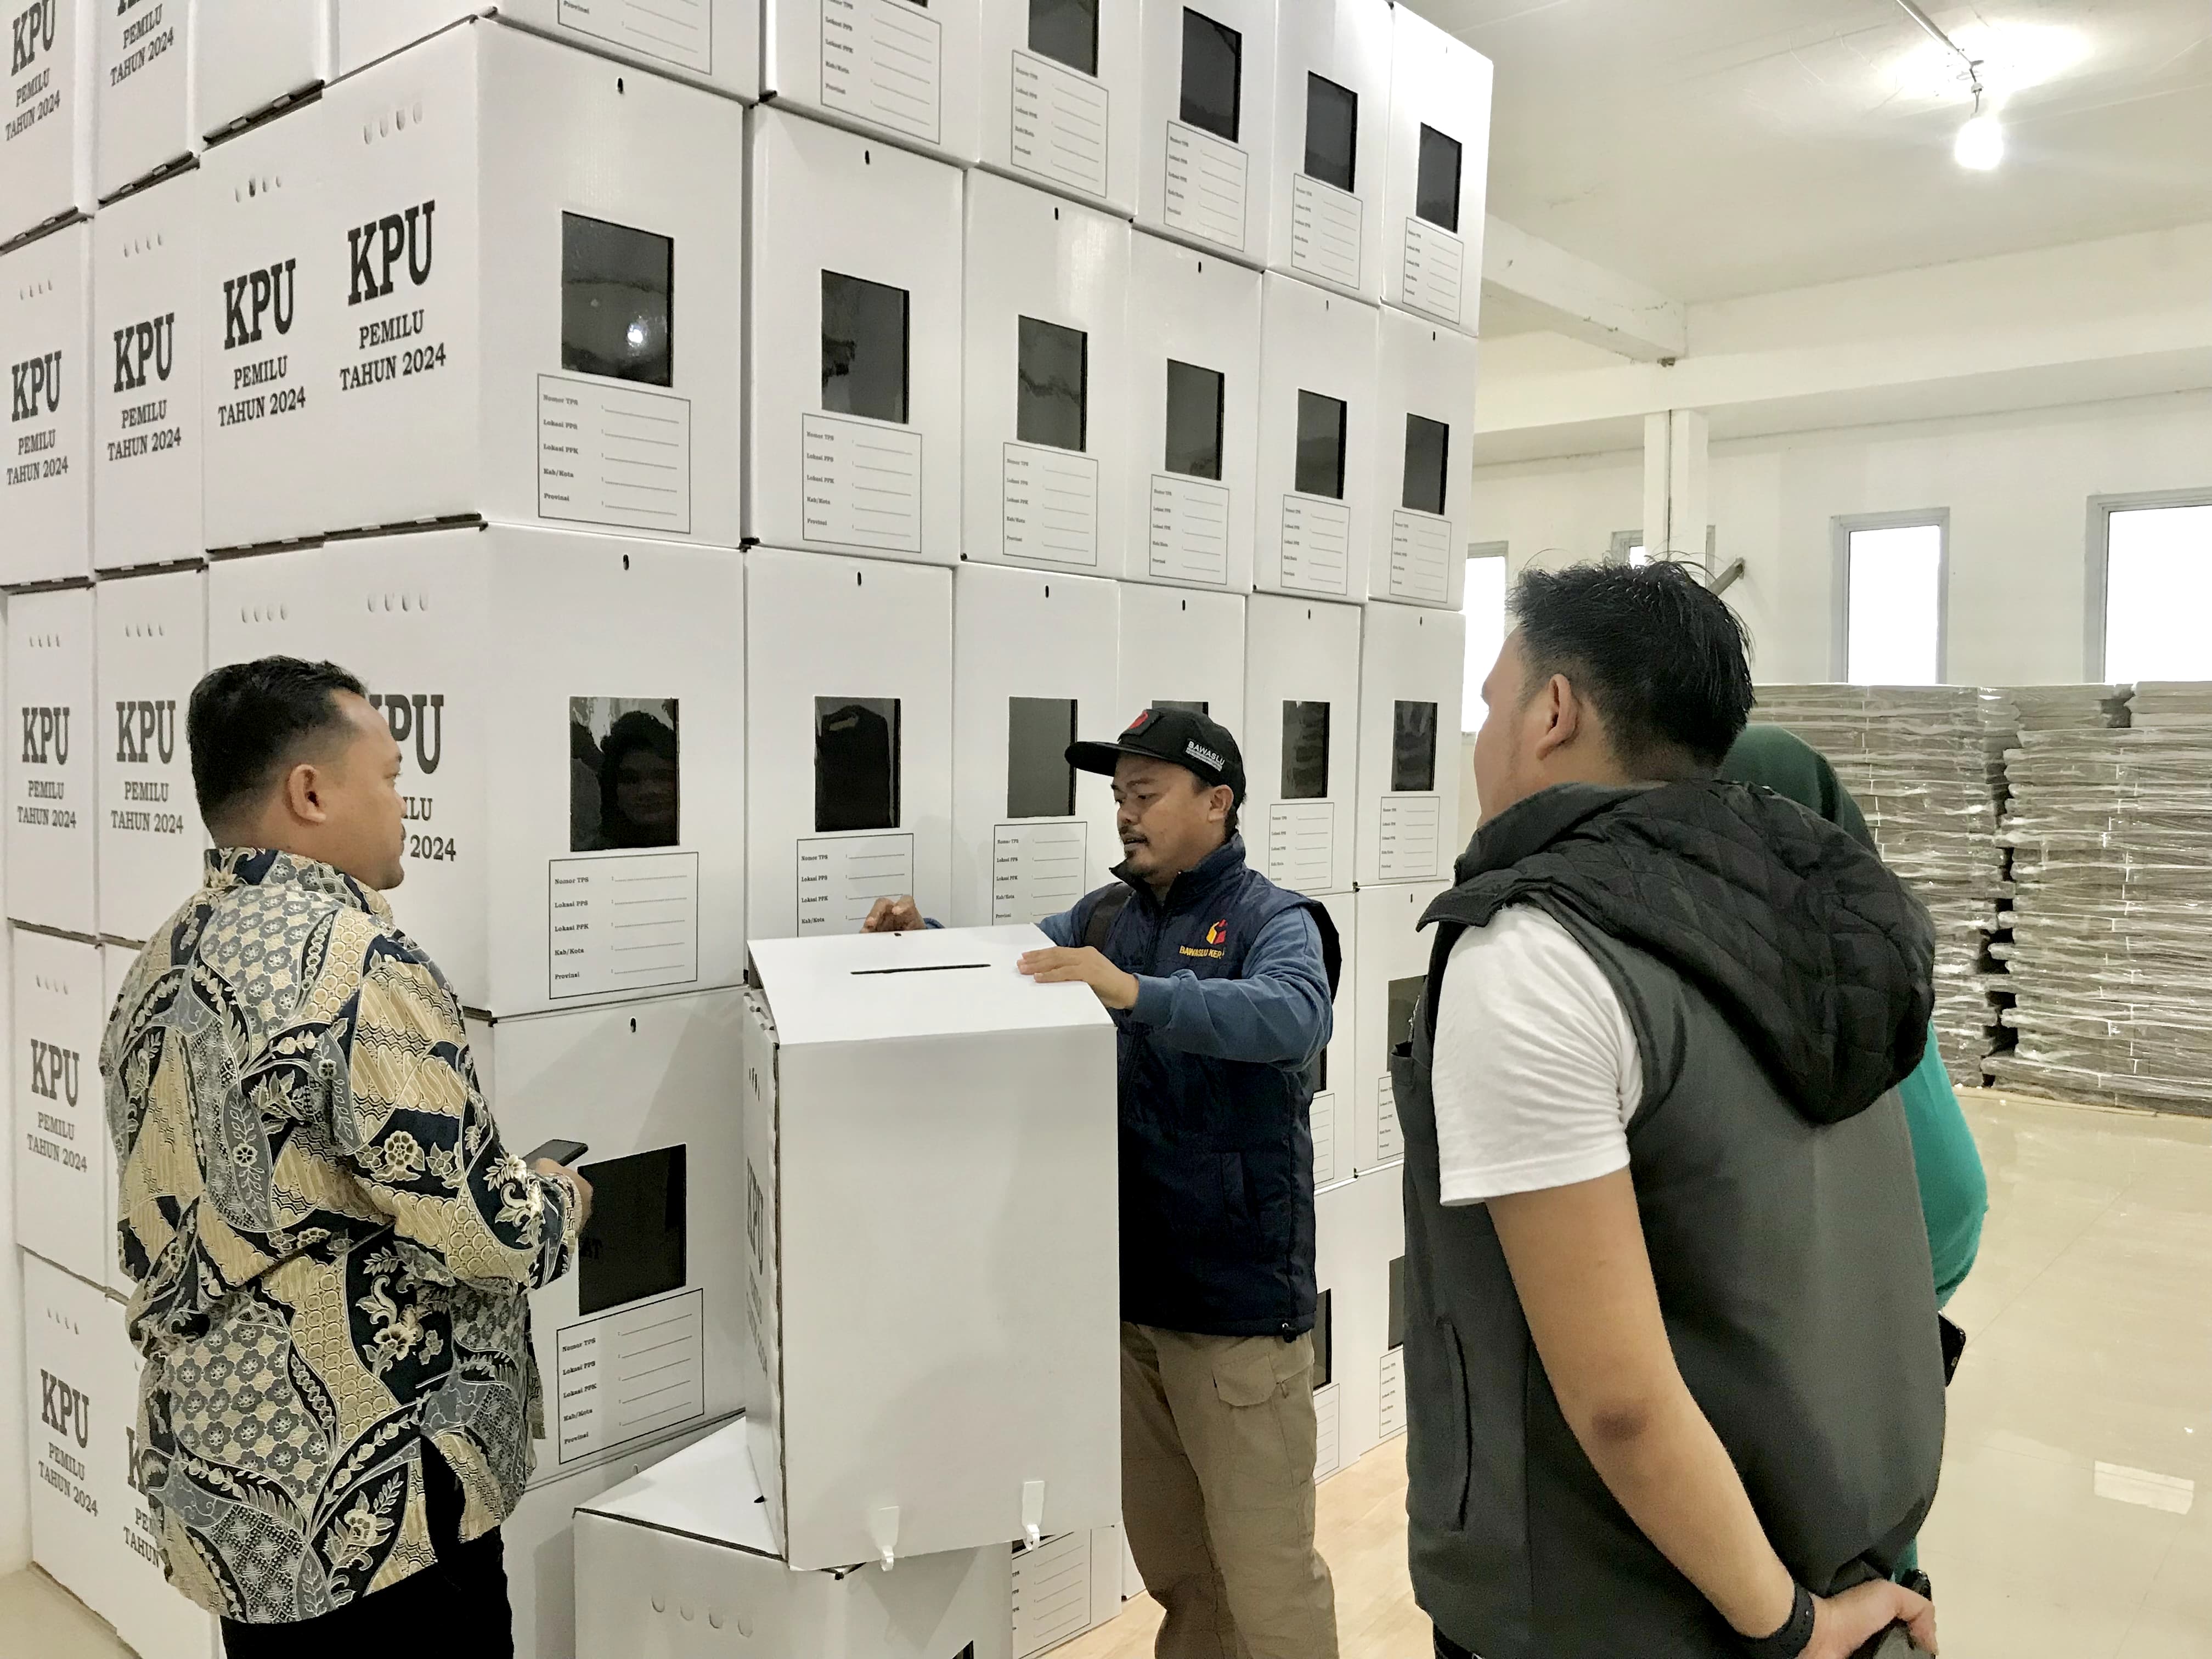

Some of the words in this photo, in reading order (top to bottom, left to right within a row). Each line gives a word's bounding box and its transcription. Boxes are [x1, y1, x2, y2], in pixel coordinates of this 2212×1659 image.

[12, 0, 55, 76] KPU
[123, 3, 162, 49] PEMILU
[111, 46, 145, 87] TAHUN
[149, 26, 173, 61] 2024
[16, 67, 50, 108] PEMILU
[5, 106, 35, 141] TAHUN
[38, 89, 60, 120] 2024
[348, 200, 435, 306] KPU
[224, 258, 296, 350] KPU
[359, 309, 424, 349] PEMILU
[114, 312, 174, 393] KPU
[234, 355, 287, 390] PEMILU
[340, 356, 397, 391] TAHUN
[403, 342, 446, 376] 2024
[12, 350, 61, 422] KPU
[218, 396, 265, 427] TAHUN
[270, 386, 306, 415] 2024
[122, 400, 167, 428] PEMILU
[18, 429, 55, 455] PEMILU
[108, 435, 148, 461] TAHUN
[151, 427, 181, 452] 2024
[7, 462, 40, 486] TAHUN
[43, 456, 68, 478] 2024
[22, 707, 70, 765] KPU
[116, 700, 176, 764] KPU
[369, 694, 444, 774] PU
[1188, 741, 1225, 765] BAWASLU
[28, 780, 64, 799] PEMILU
[125, 781, 169, 802] PEMILU
[18, 806, 49, 825] TAHUN
[52, 810, 76, 828] 2024
[111, 810, 150, 831] TAHUN
[154, 813, 184, 834] 2024
[410, 835, 456, 861] 2024
[1179, 945, 1209, 956] BAWASLU
[31, 1039, 80, 1107] KPU
[38, 1111, 75, 1141] PEMILU
[27, 1133, 60, 1162] TAHUN
[63, 1148, 87, 1172] 2024
[40, 1369, 89, 1448] KPU
[48, 1442, 85, 1481] PEMILU
[38, 1461, 71, 1498] TAHUN
[74, 1486, 99, 1517] 2024
[123, 1526, 159, 1567] TAHUN
